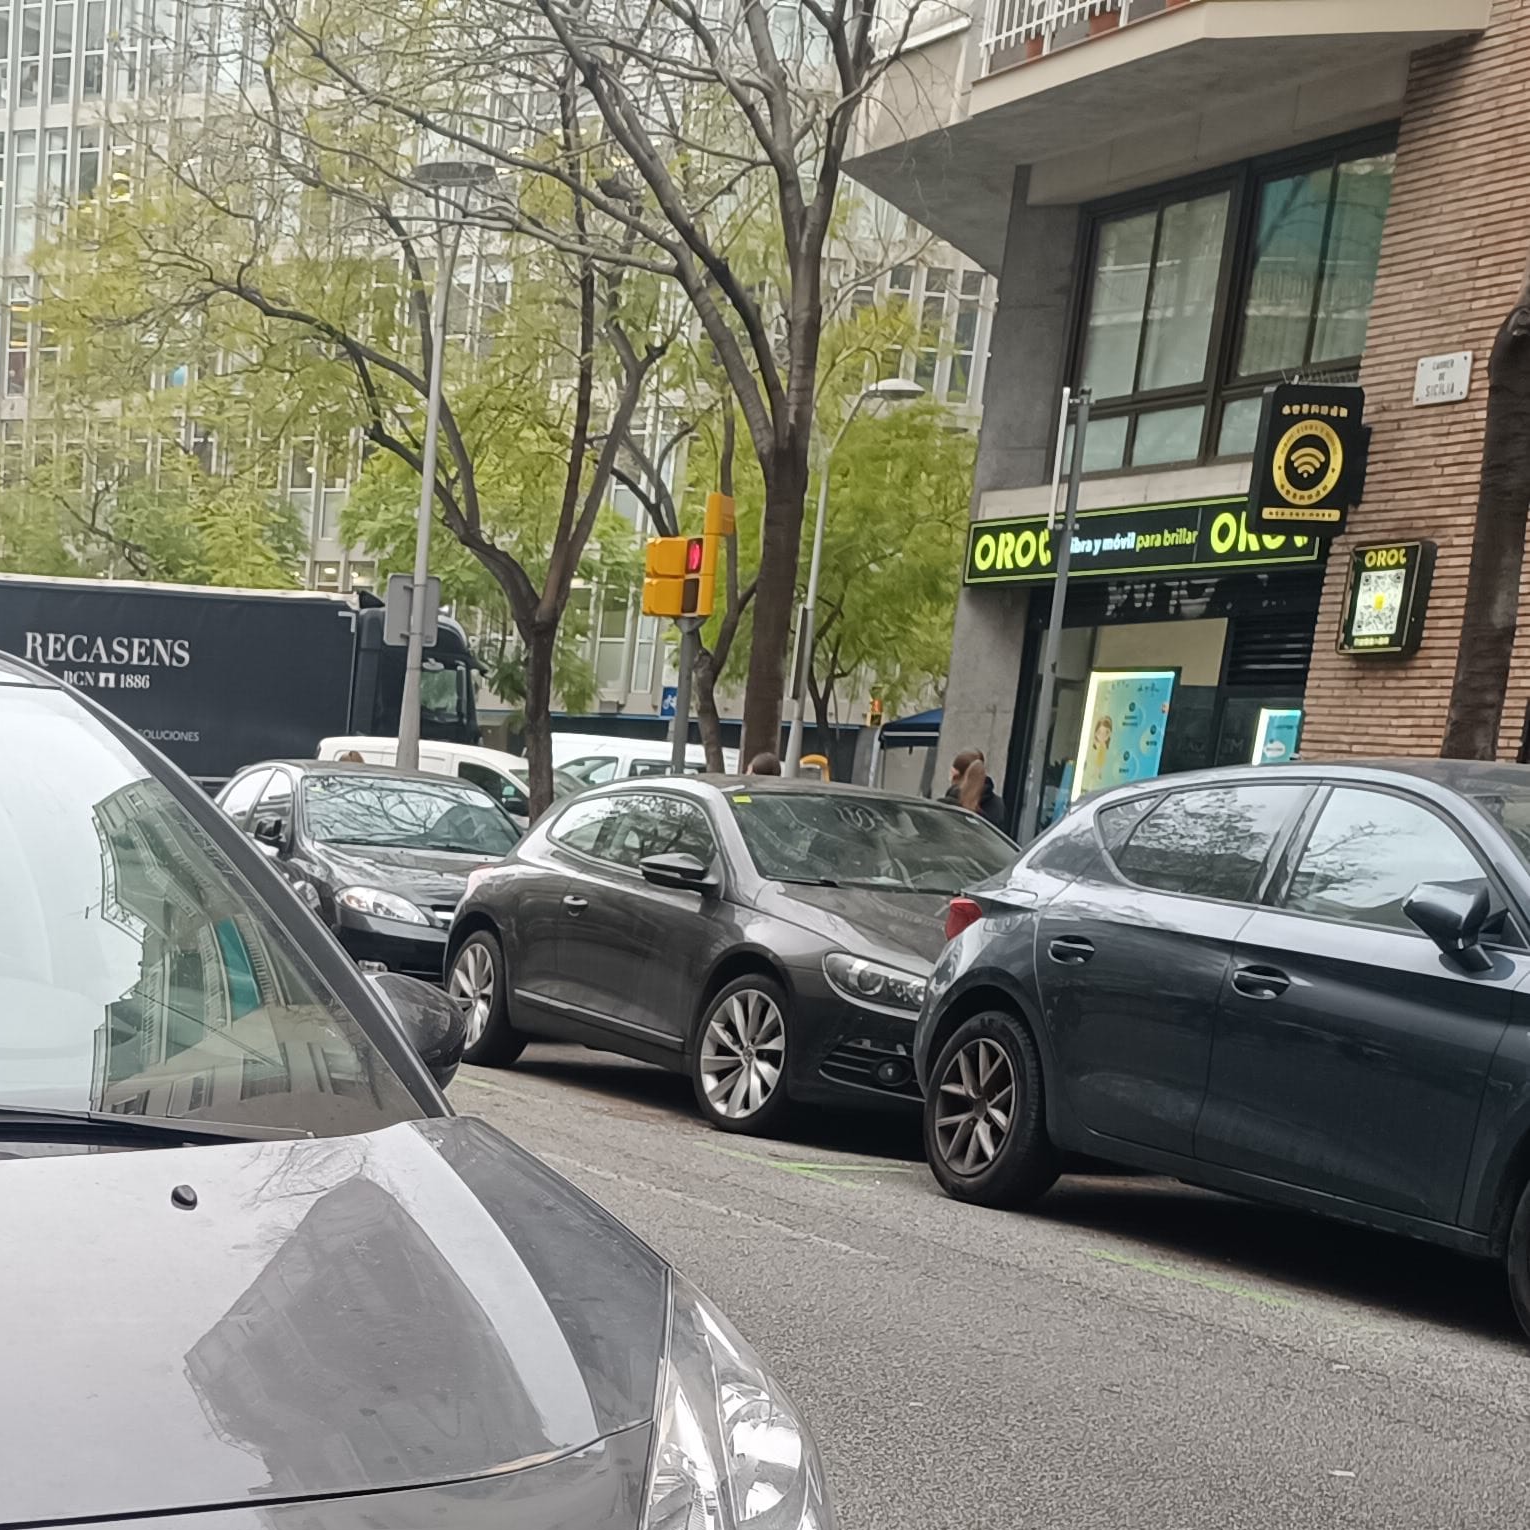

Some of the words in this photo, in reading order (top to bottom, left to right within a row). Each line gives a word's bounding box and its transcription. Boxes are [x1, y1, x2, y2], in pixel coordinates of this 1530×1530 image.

[1102, 532, 1136, 551] móvil
[1136, 534, 1162, 552] para
[1162, 528, 1198, 547] brillar
[25, 632, 190, 667] RECASENS
[63, 670, 95, 687] BCN
[120, 674, 150, 689] 1886
